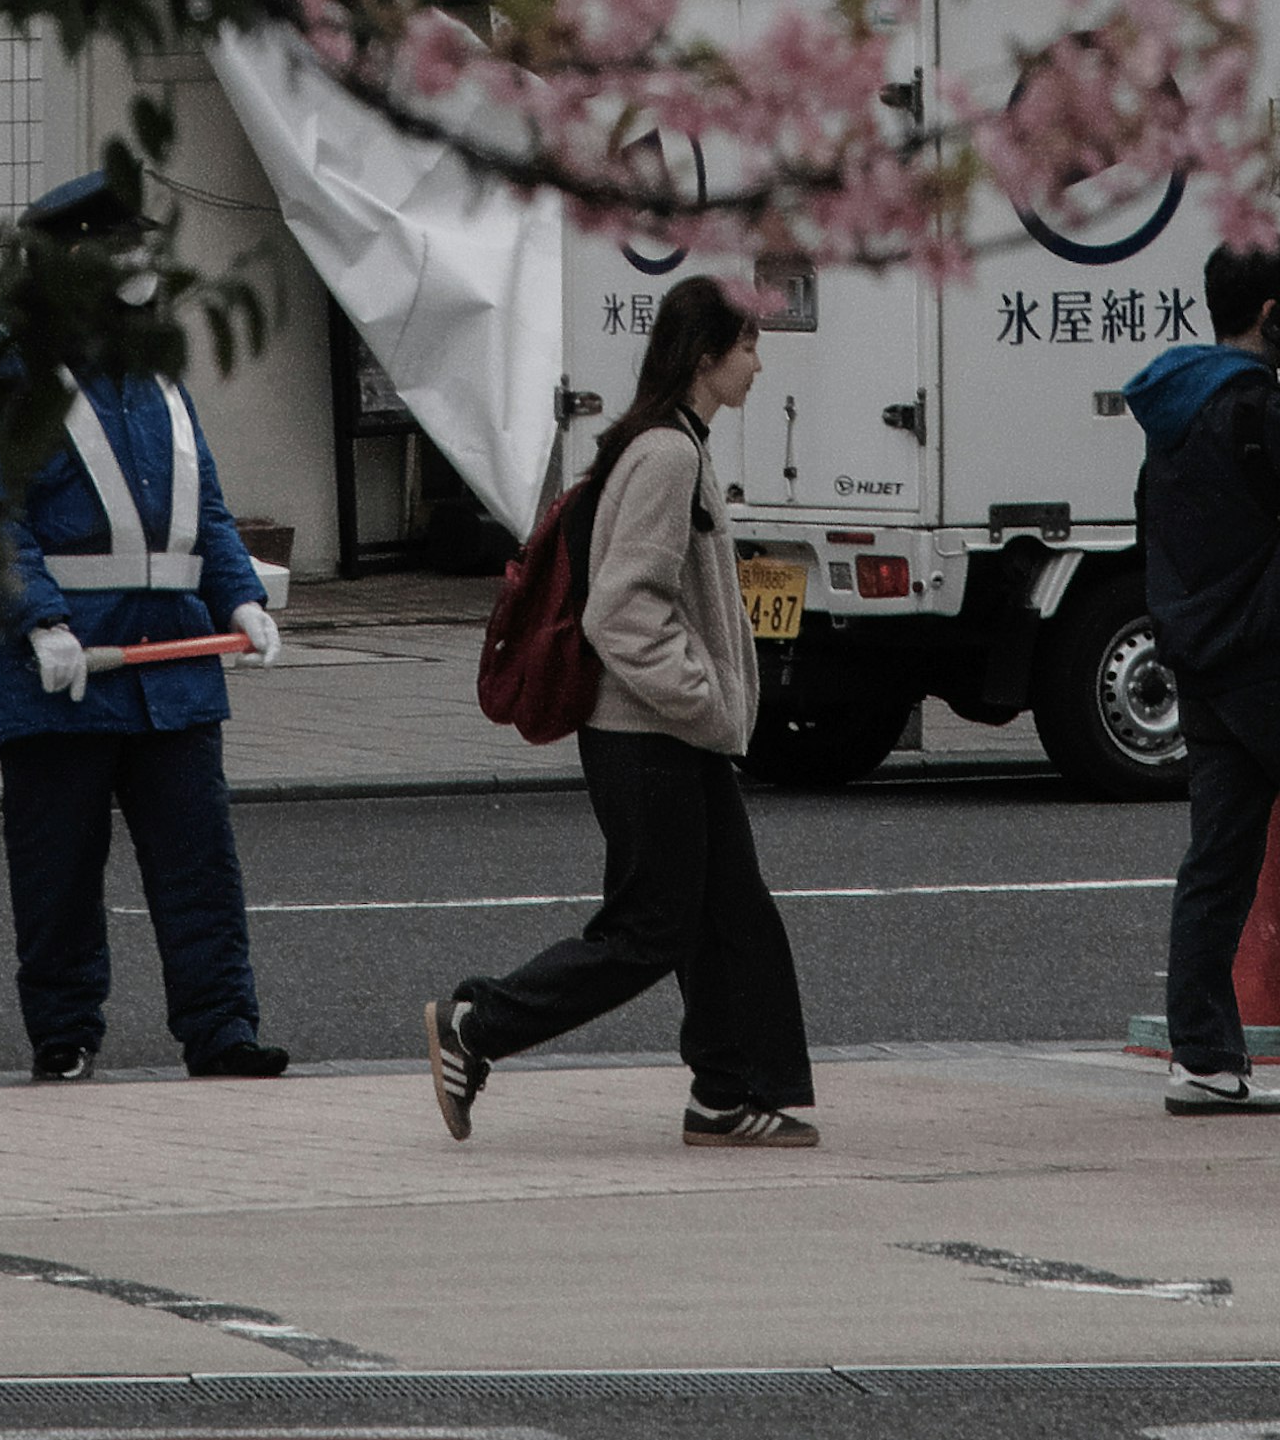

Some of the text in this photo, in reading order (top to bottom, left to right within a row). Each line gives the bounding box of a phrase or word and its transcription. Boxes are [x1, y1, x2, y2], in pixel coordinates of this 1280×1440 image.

[996, 287, 1199, 346] 氷屋純氷
[856, 481, 904, 495] HIJET
